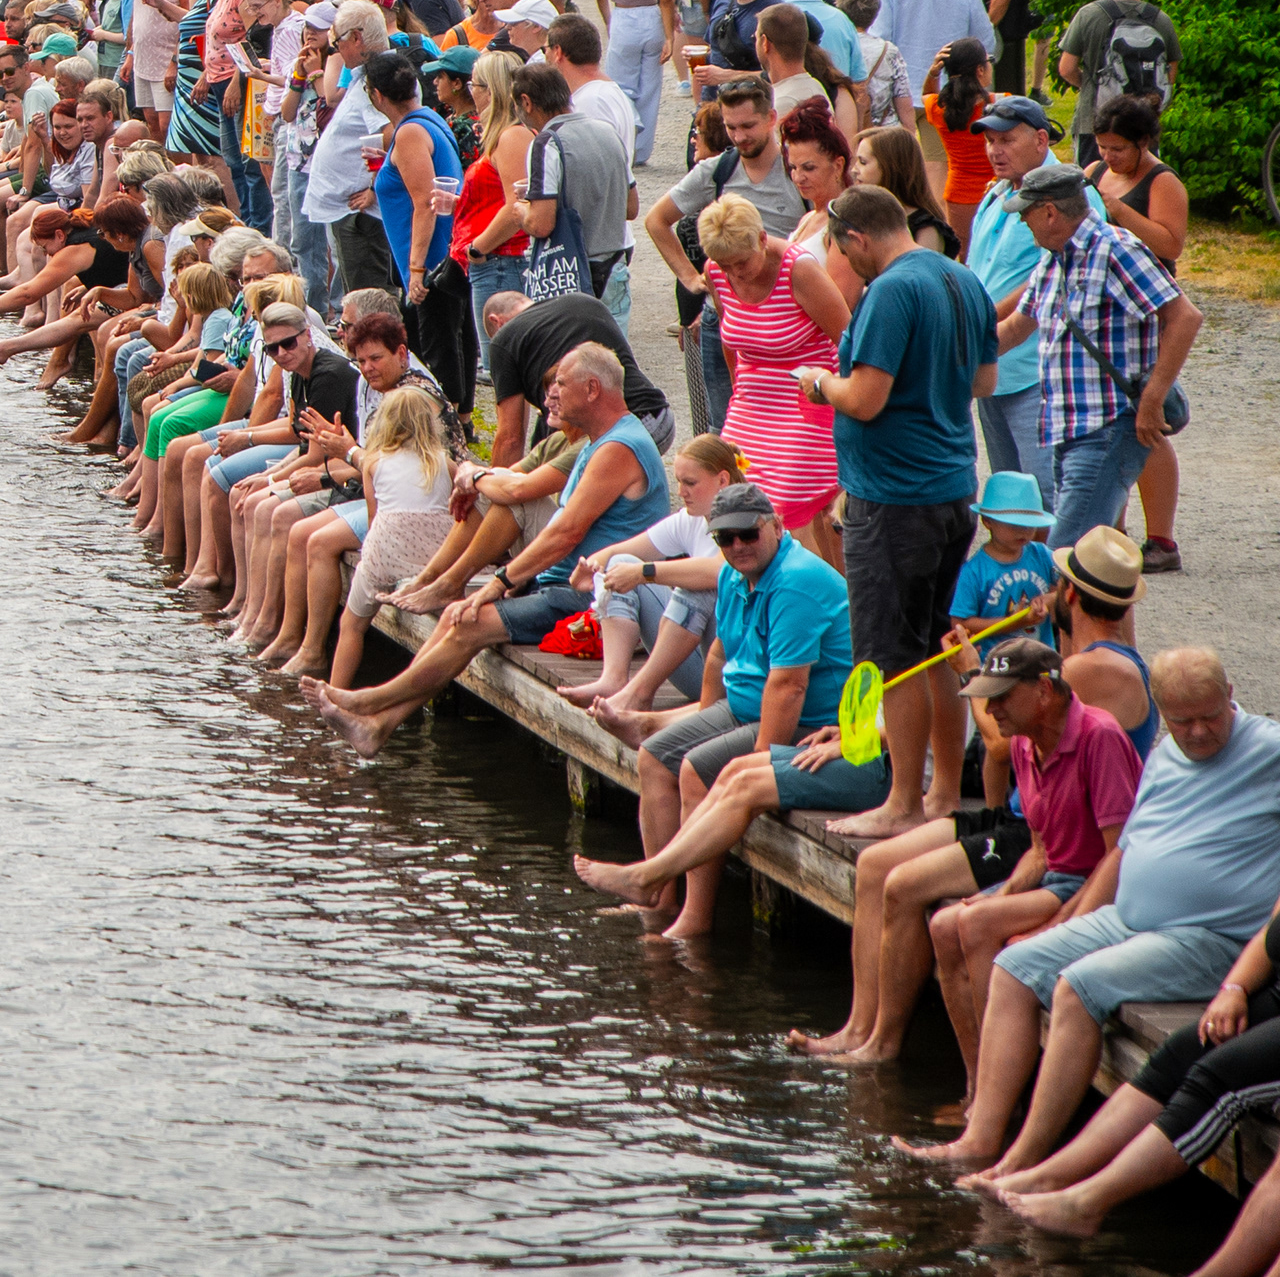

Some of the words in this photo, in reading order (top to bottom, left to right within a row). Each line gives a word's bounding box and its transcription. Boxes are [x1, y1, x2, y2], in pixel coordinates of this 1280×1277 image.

[552, 256, 578, 274] AM
[1012, 569, 1029, 582] DO
[990, 657, 1010, 673] 15
